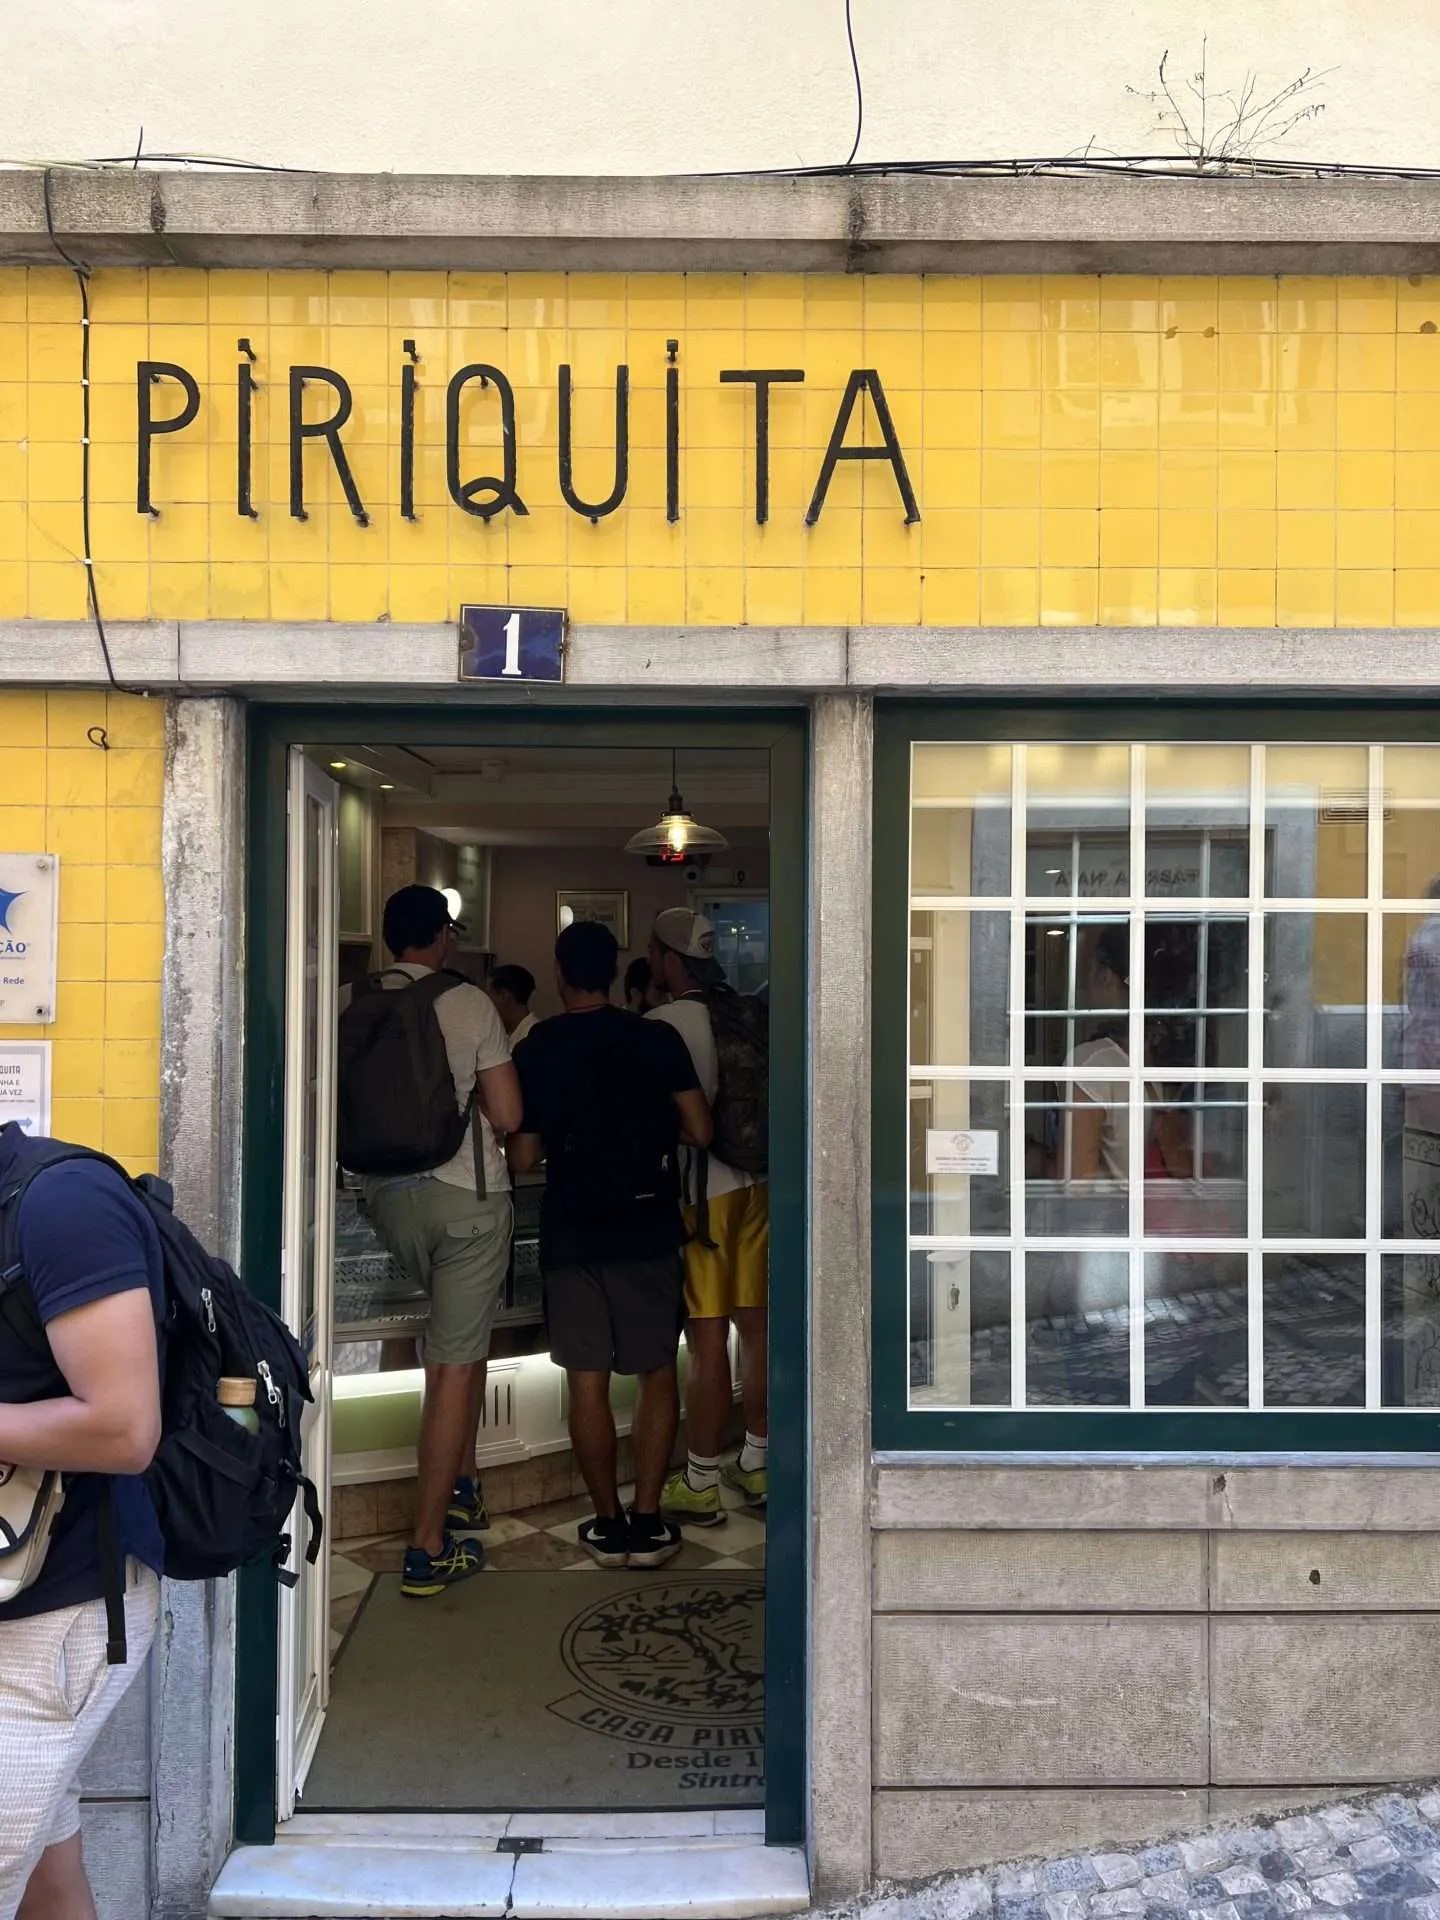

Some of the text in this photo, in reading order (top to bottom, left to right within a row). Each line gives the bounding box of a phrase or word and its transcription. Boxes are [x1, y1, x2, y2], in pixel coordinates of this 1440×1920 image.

[137, 338, 921, 526] PIRIQUITA
[501, 613, 522, 675] 1
[3, 976, 25, 985] Rede
[579, 1707, 675, 1744] CASA
[626, 1752, 731, 1769] Desde
